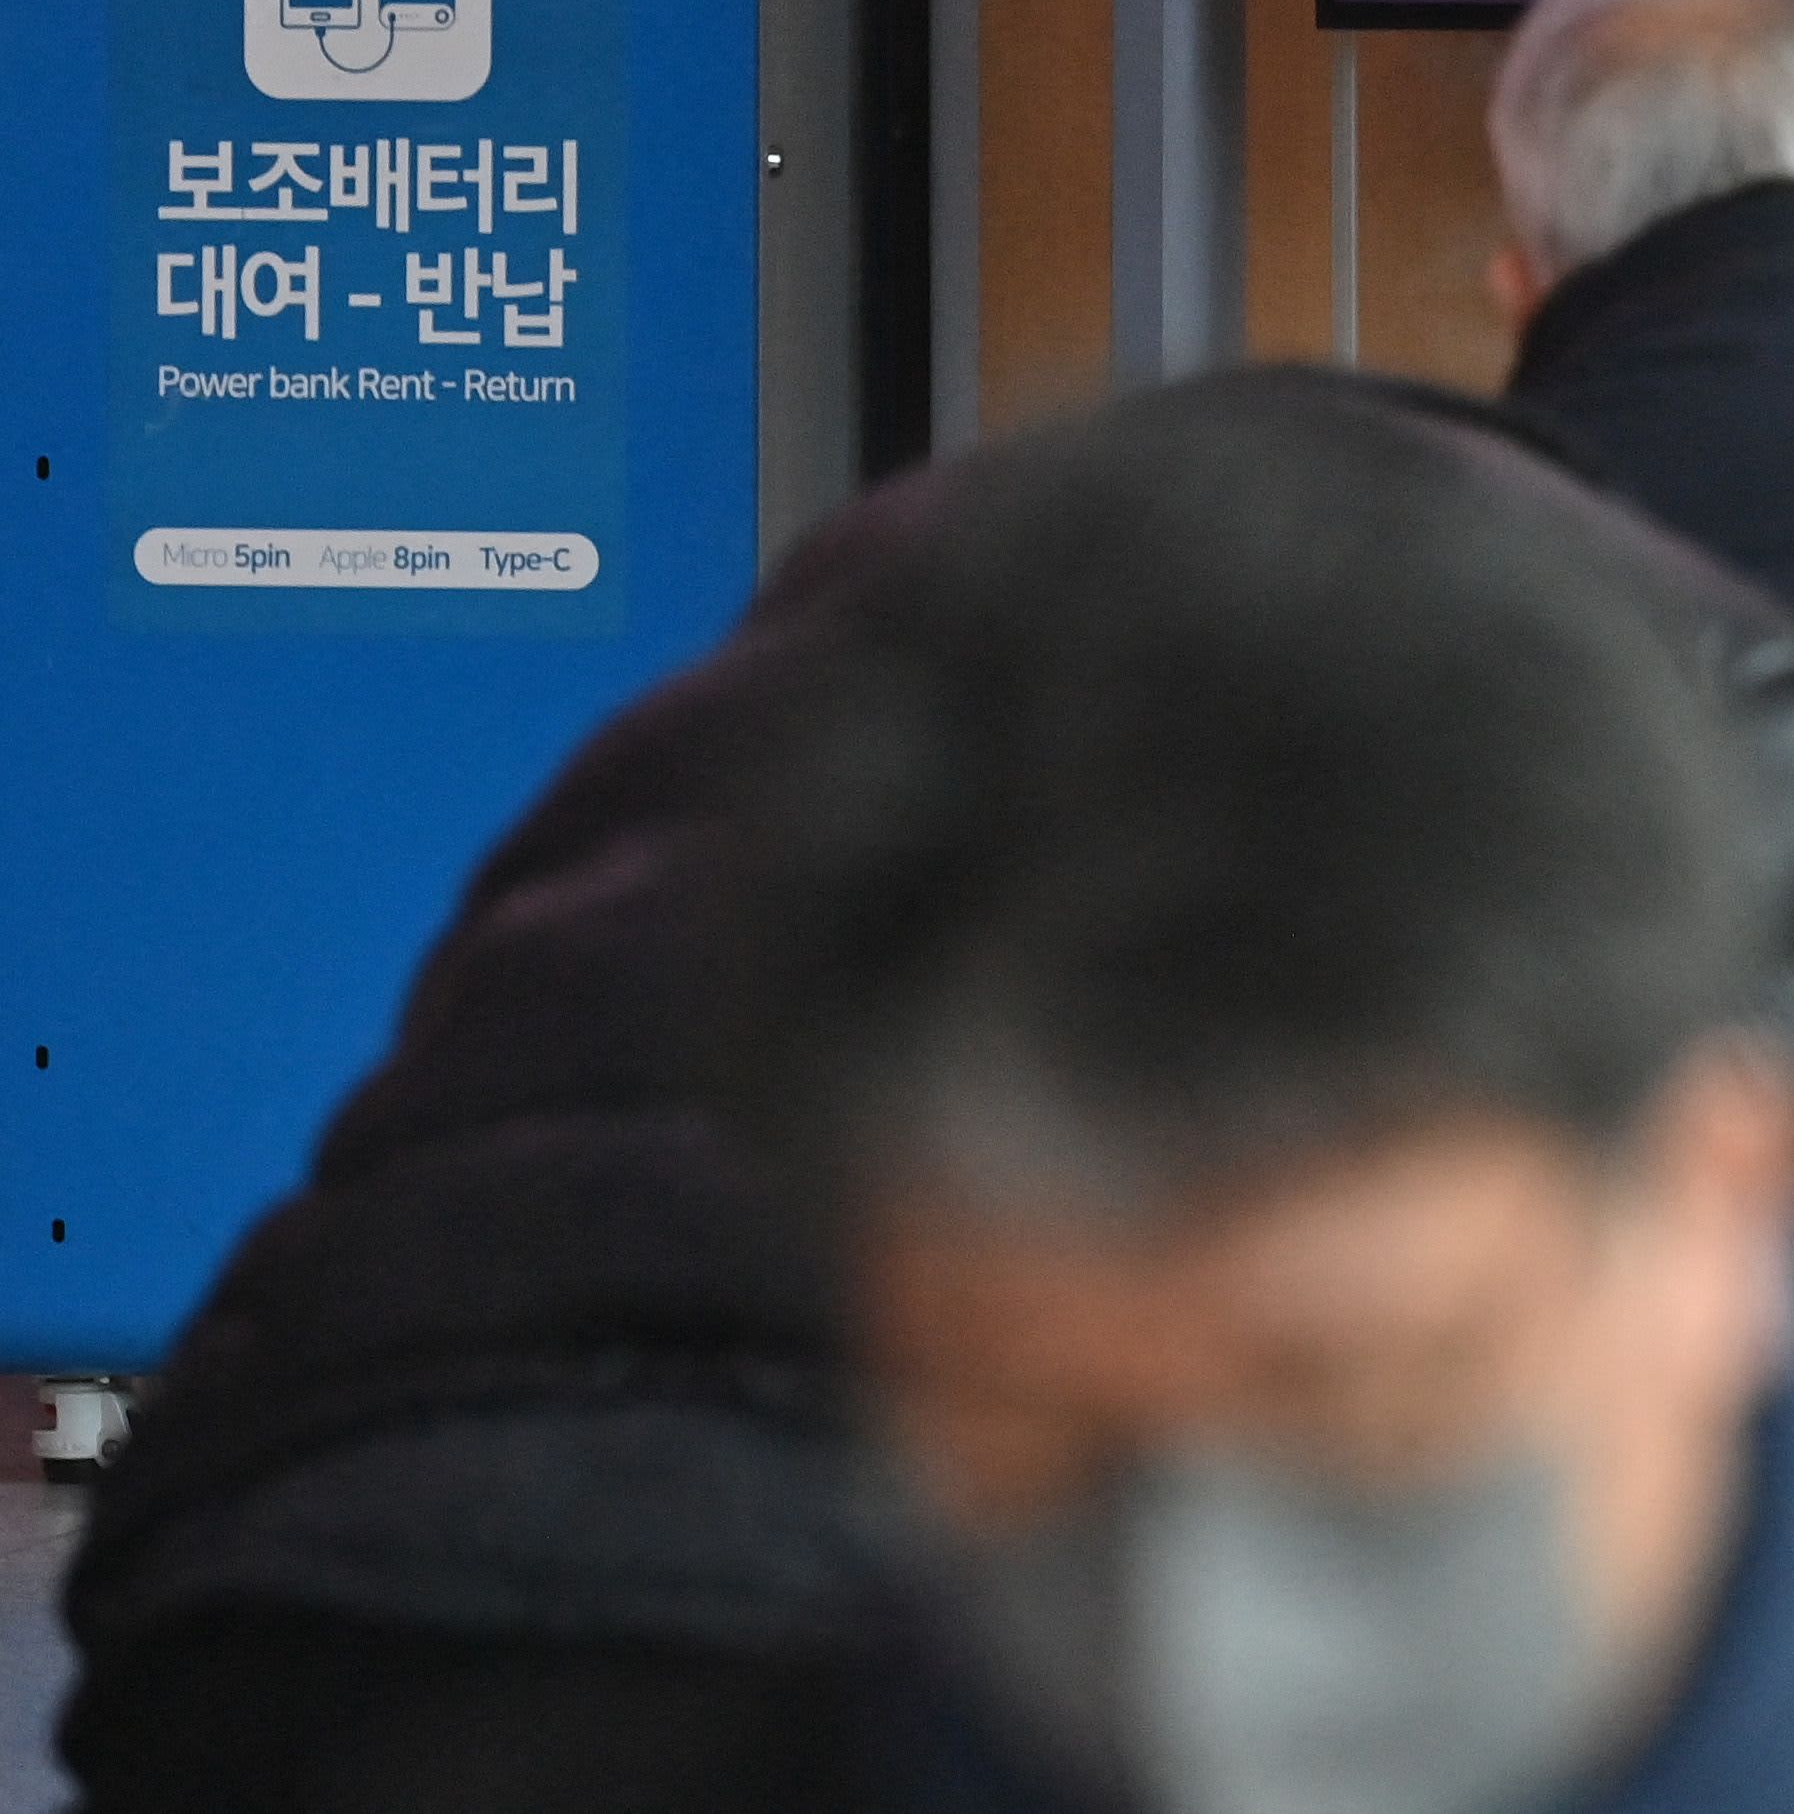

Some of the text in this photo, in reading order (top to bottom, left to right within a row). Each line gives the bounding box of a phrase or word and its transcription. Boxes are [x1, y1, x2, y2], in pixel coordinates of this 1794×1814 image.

[157, 137, 578, 235] 보조배터리
[156, 244, 320, 341] 대여
[405, 247, 578, 348] 반납
[158, 365, 262, 399] Power
[269, 365, 351, 399] bank
[358, 367, 436, 401] Rent
[464, 369, 576, 403] Return
[162, 542, 572, 578] Micro 5pin Apple 8pin Type-C
